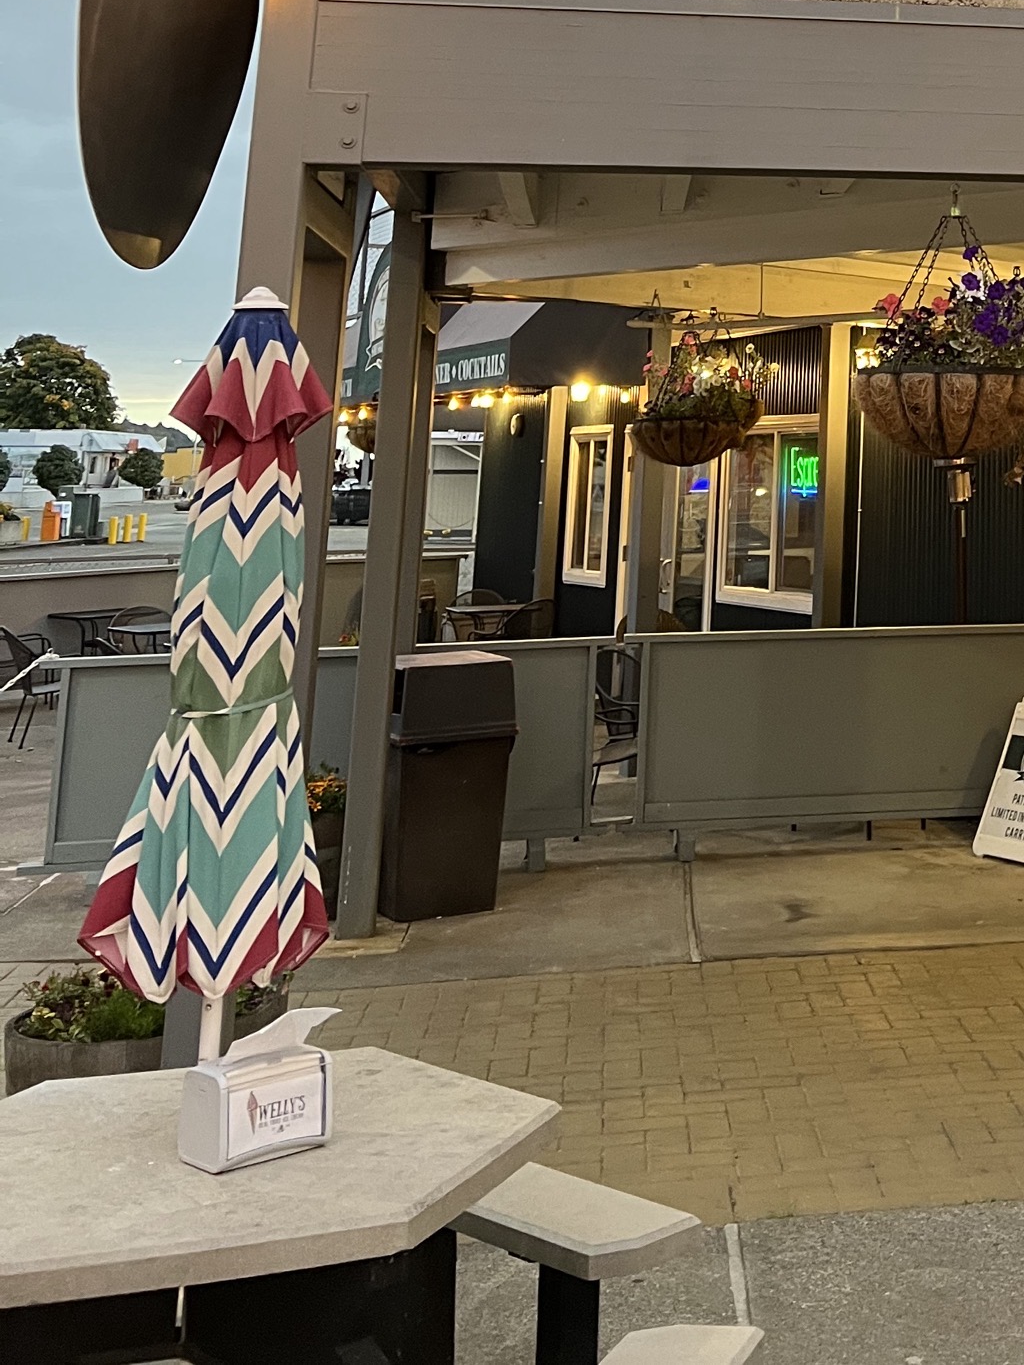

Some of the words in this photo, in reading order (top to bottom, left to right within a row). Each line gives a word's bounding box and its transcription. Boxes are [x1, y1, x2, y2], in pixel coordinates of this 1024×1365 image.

[435, 362, 451, 385] NER
[457, 352, 506, 382] COCKTAILS
[990, 806, 1018, 822] LIMITED
[258, 1095, 306, 1121] WELLY'S
